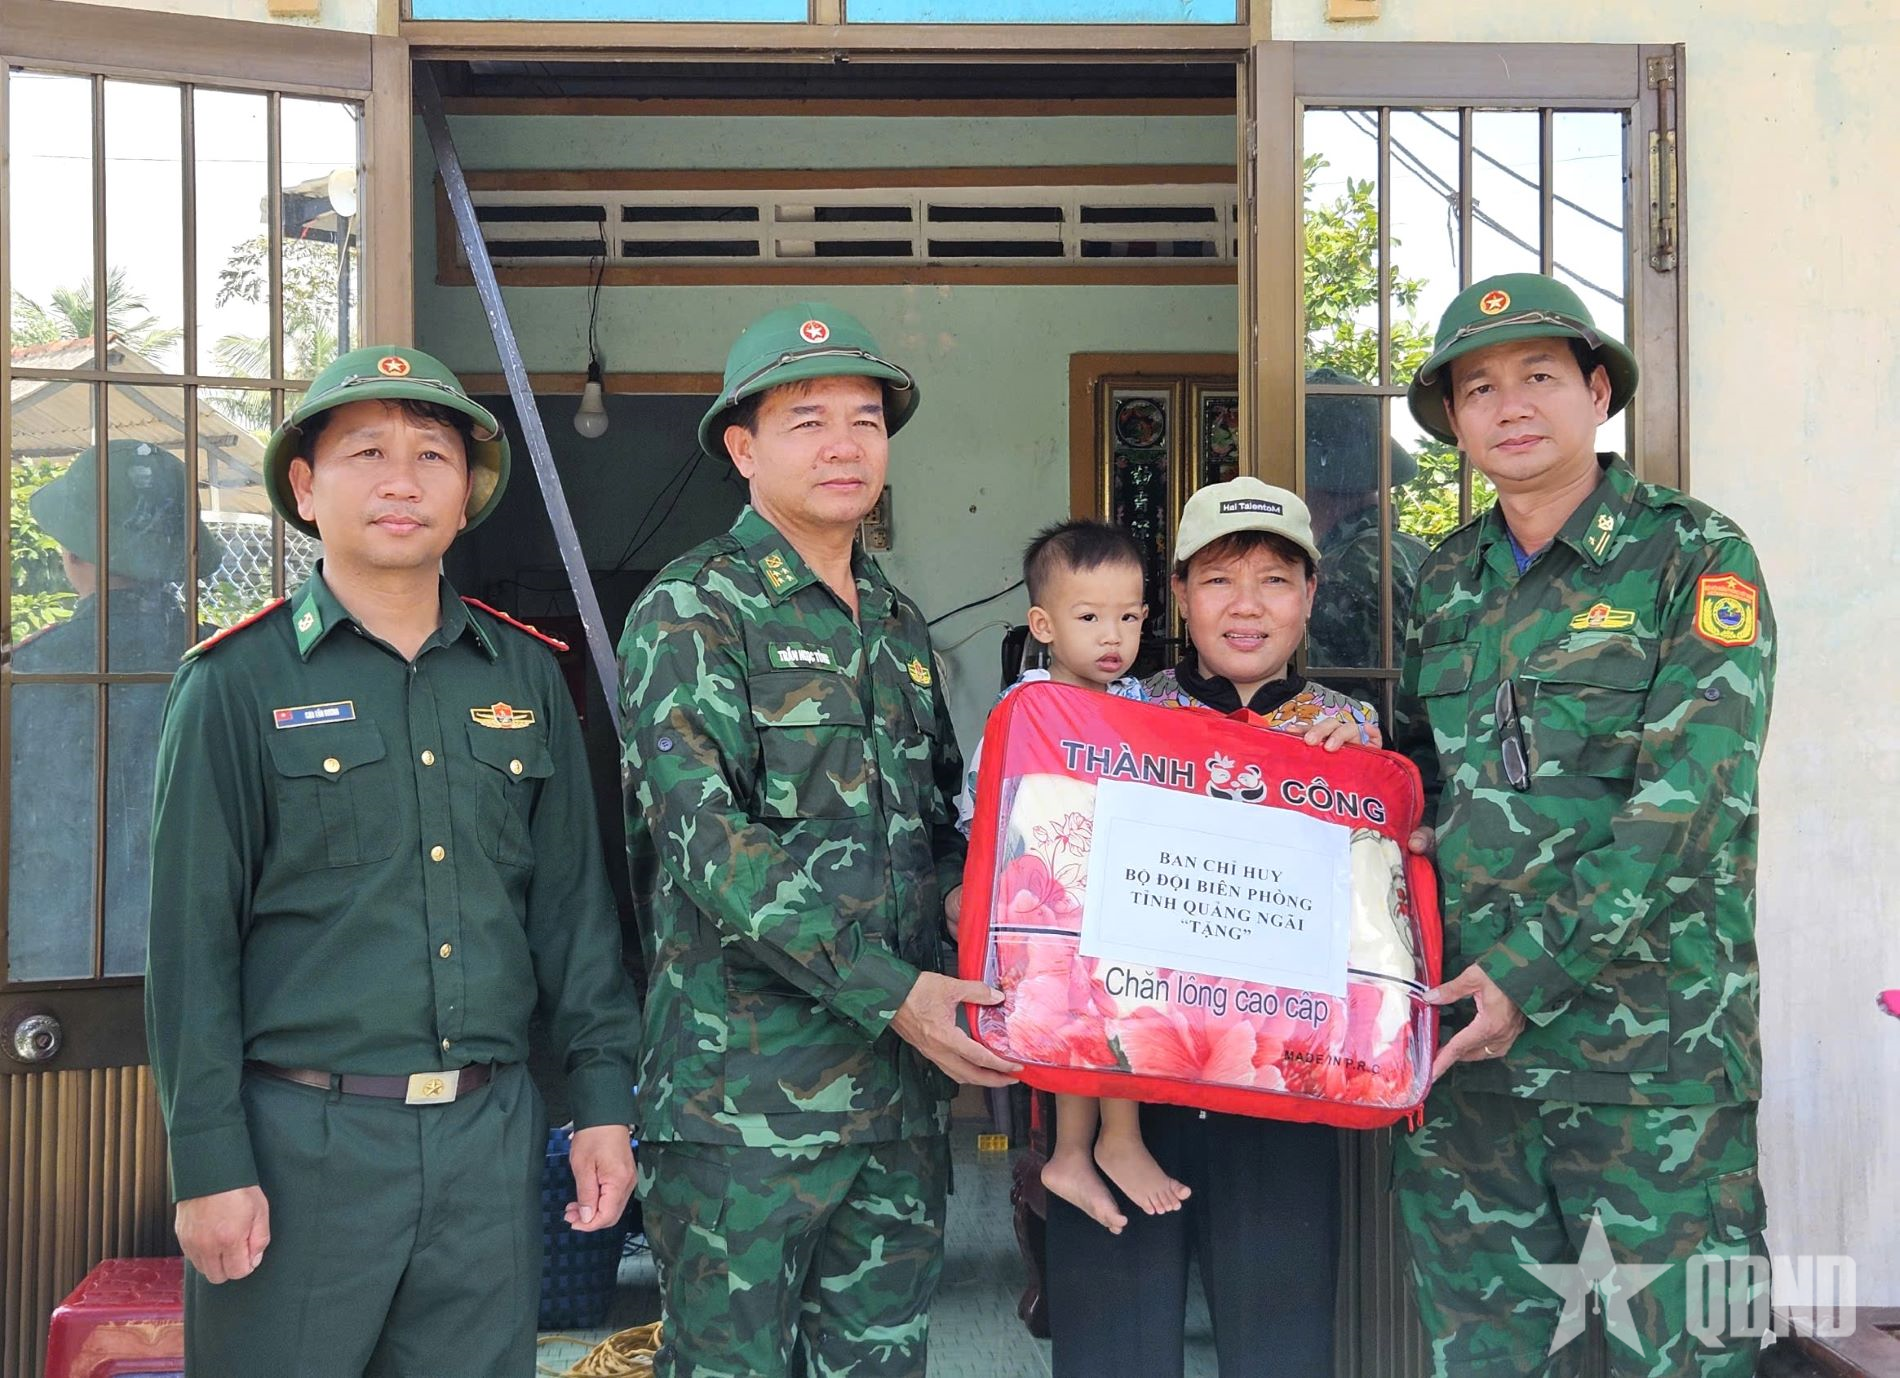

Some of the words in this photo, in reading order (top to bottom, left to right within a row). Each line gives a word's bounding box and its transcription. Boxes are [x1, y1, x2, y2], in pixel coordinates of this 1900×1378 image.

[1061, 740, 1194, 788] THÀNH
[1280, 777, 1386, 824] CÔNG
[1160, 851, 1197, 869] BAN
[1243, 866, 1283, 883] HUY
[1125, 868, 1150, 886] BỘ
[1157, 871, 1190, 892] ĐỘI
[1197, 879, 1241, 898] BIÊN
[1247, 888, 1313, 912] PHÒNG
[1257, 911, 1304, 931] NGÃI
[1105, 966, 1169, 1002] Chăn
[1178, 975, 1227, 1016] lông
[1235, 989, 1278, 1016] cao
[1284, 1050, 1323, 1065] MADE
[1328, 1055, 1341, 1067] IN
